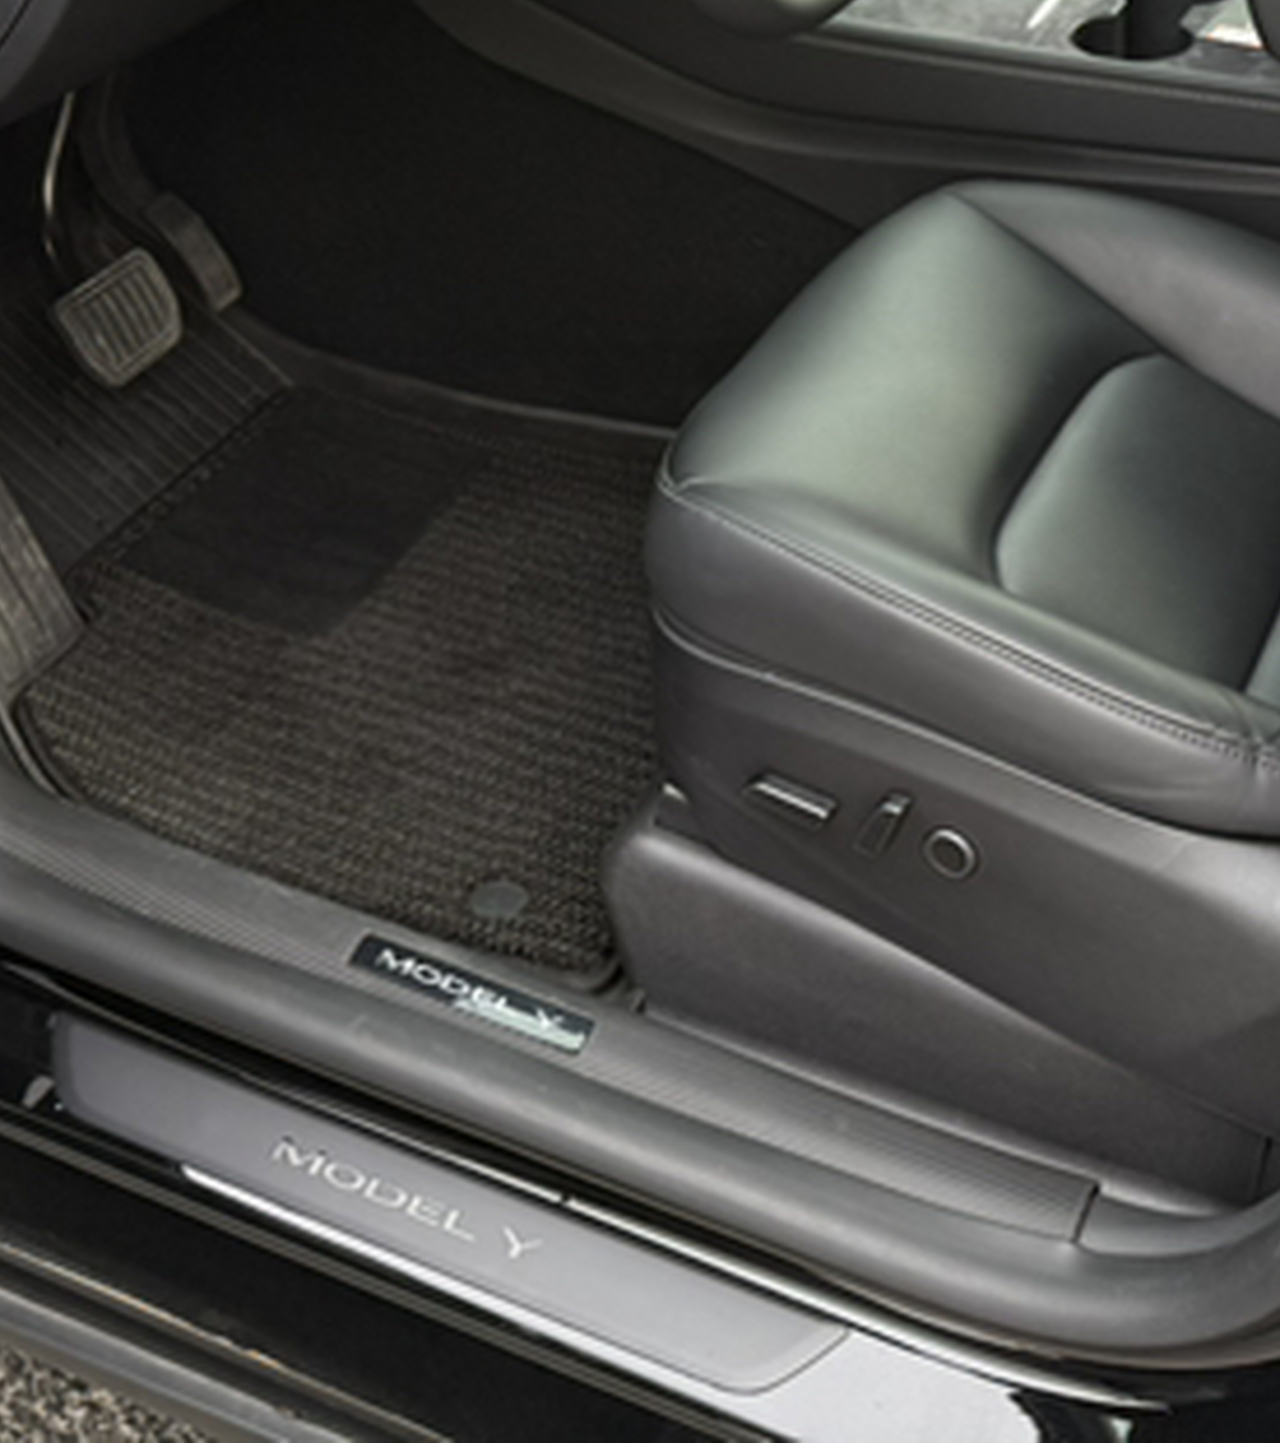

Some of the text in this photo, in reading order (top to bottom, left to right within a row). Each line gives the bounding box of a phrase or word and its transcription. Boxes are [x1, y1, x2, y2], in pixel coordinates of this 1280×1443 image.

[374, 948, 512, 1014] MODEL
[272, 1140, 544, 1259] MODEL Y
